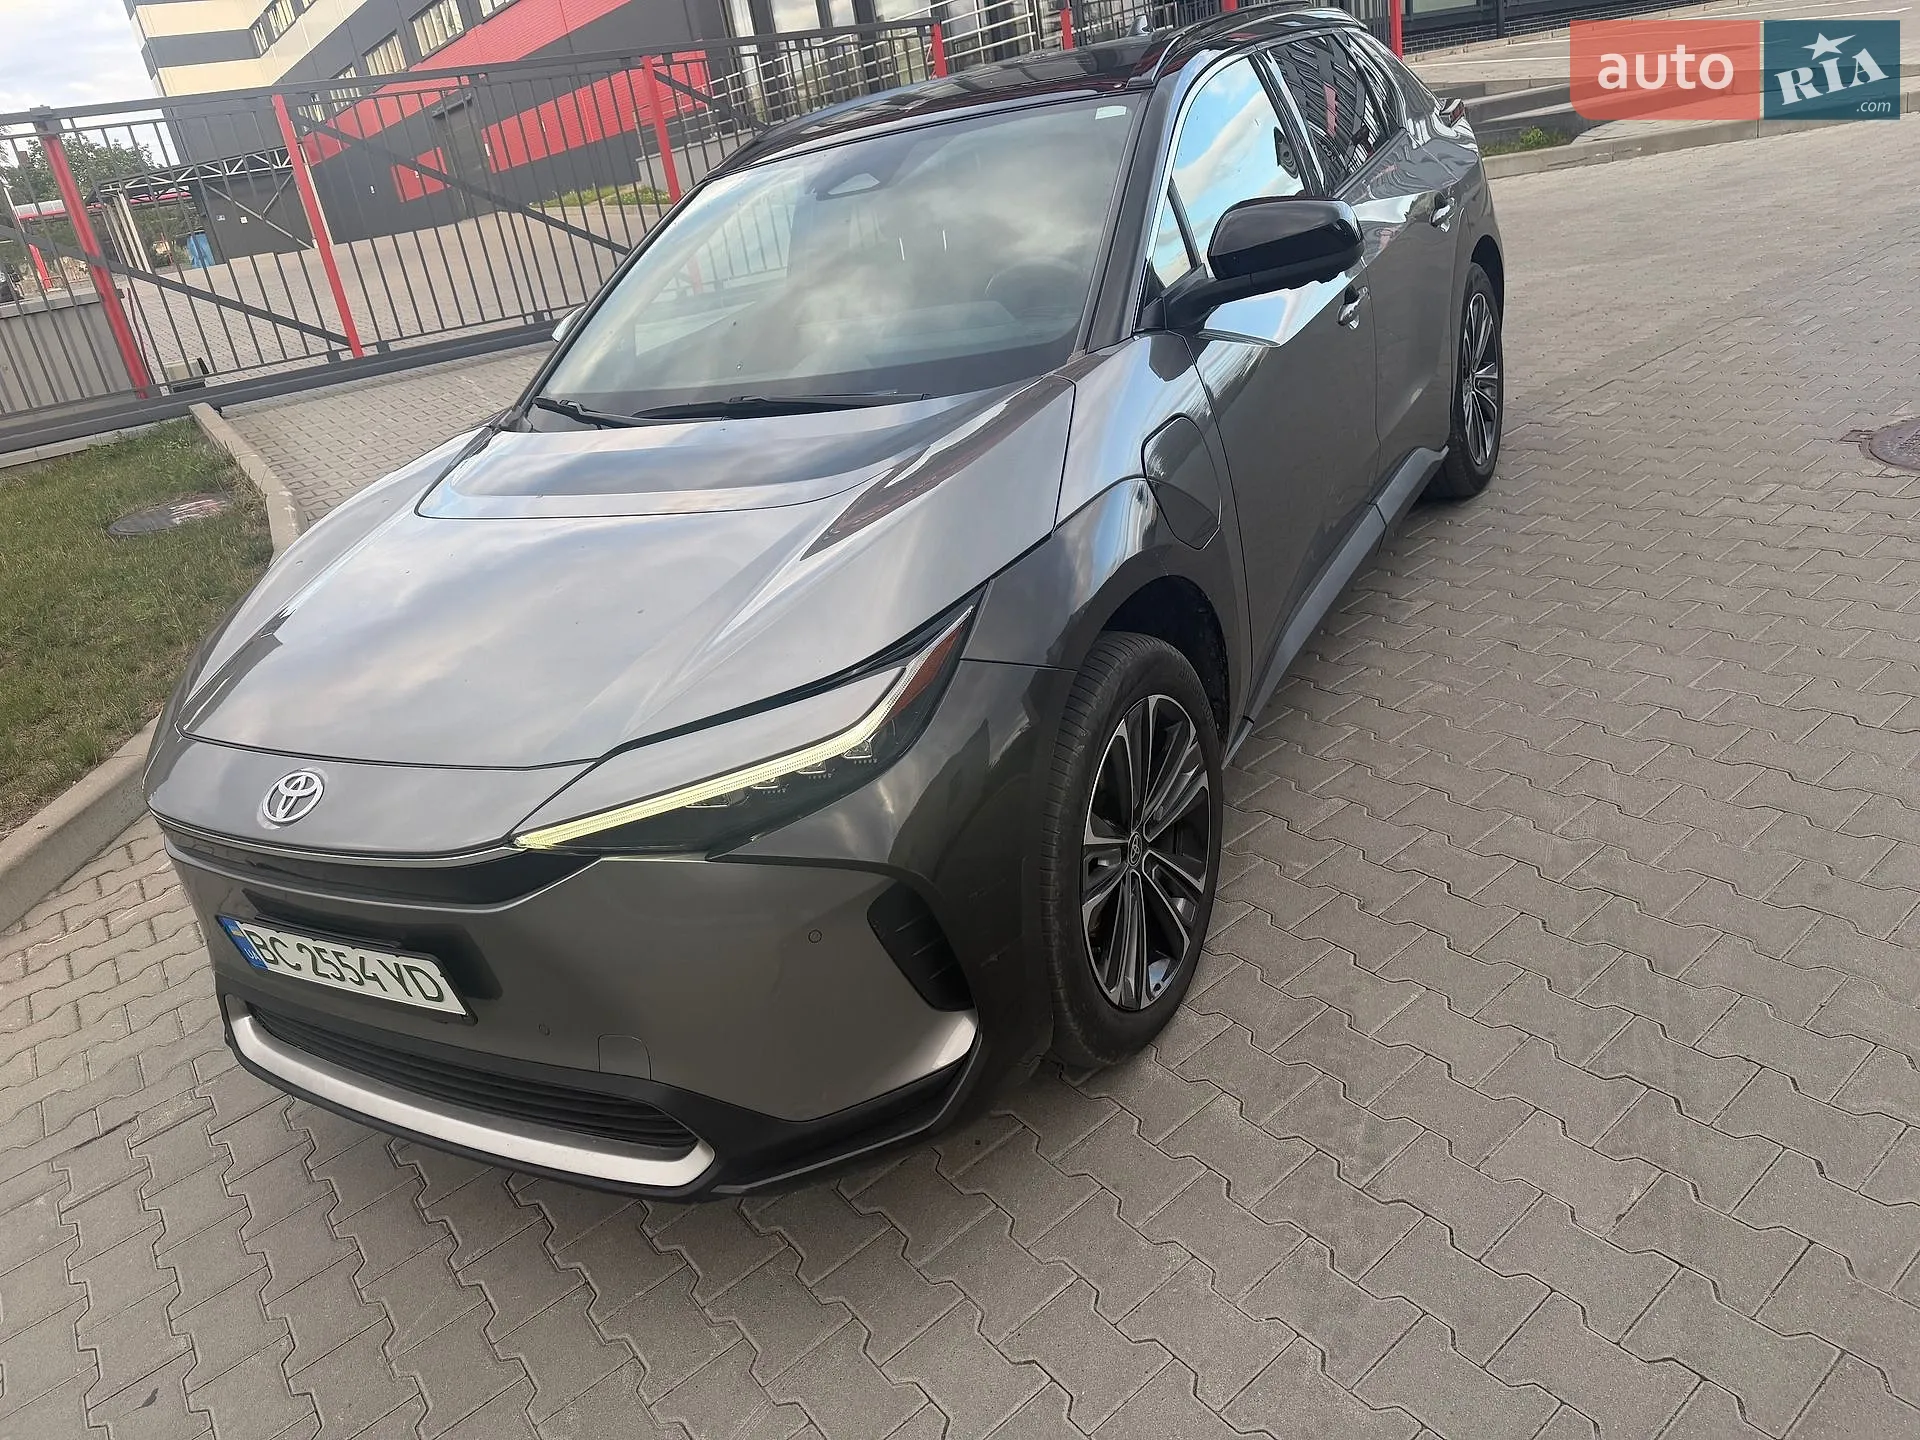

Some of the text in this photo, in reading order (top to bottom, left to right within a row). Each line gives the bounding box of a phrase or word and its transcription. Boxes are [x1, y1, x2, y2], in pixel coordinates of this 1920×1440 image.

[243, 930, 444, 1002] BC 2554 YD
[244, 947, 262, 961] UA
